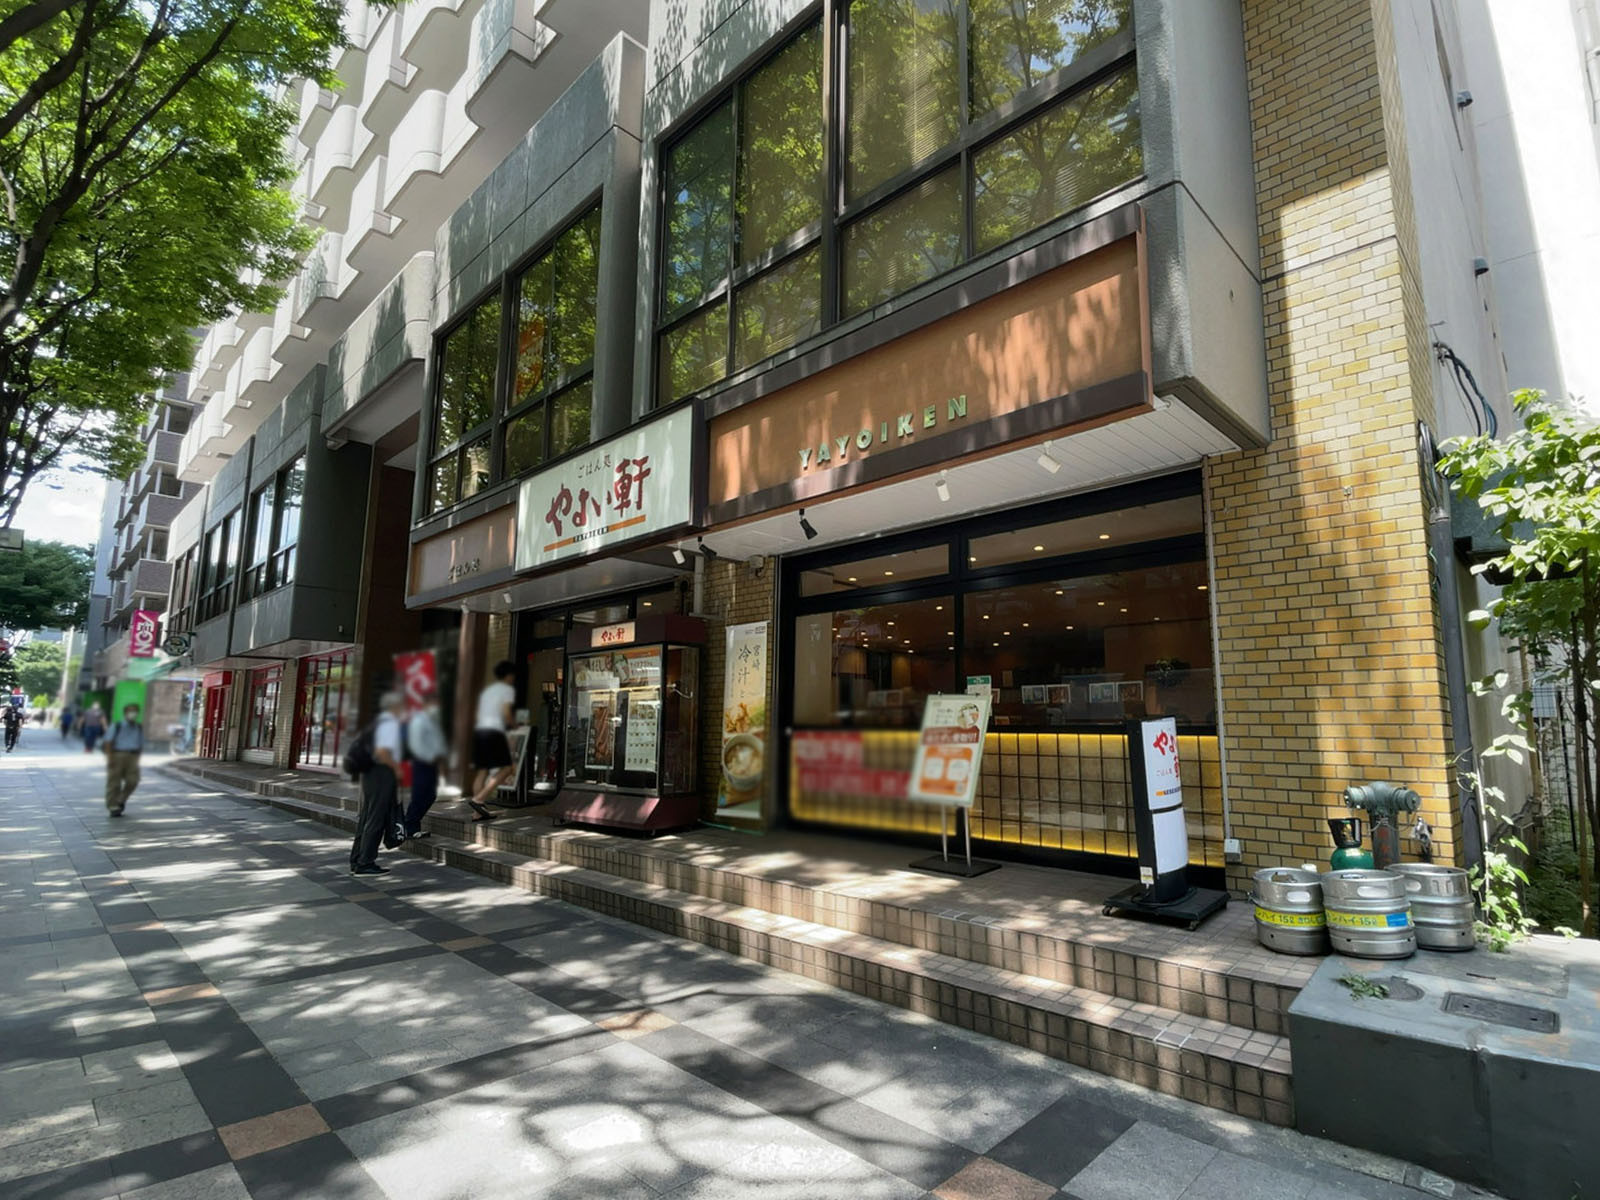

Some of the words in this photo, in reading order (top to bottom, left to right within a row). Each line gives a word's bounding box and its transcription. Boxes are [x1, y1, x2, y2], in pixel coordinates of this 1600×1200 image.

[578, 454, 612, 479] ごはん処
[798, 394, 968, 470] YAYOIKEN
[545, 455, 652, 537] やよい軒
